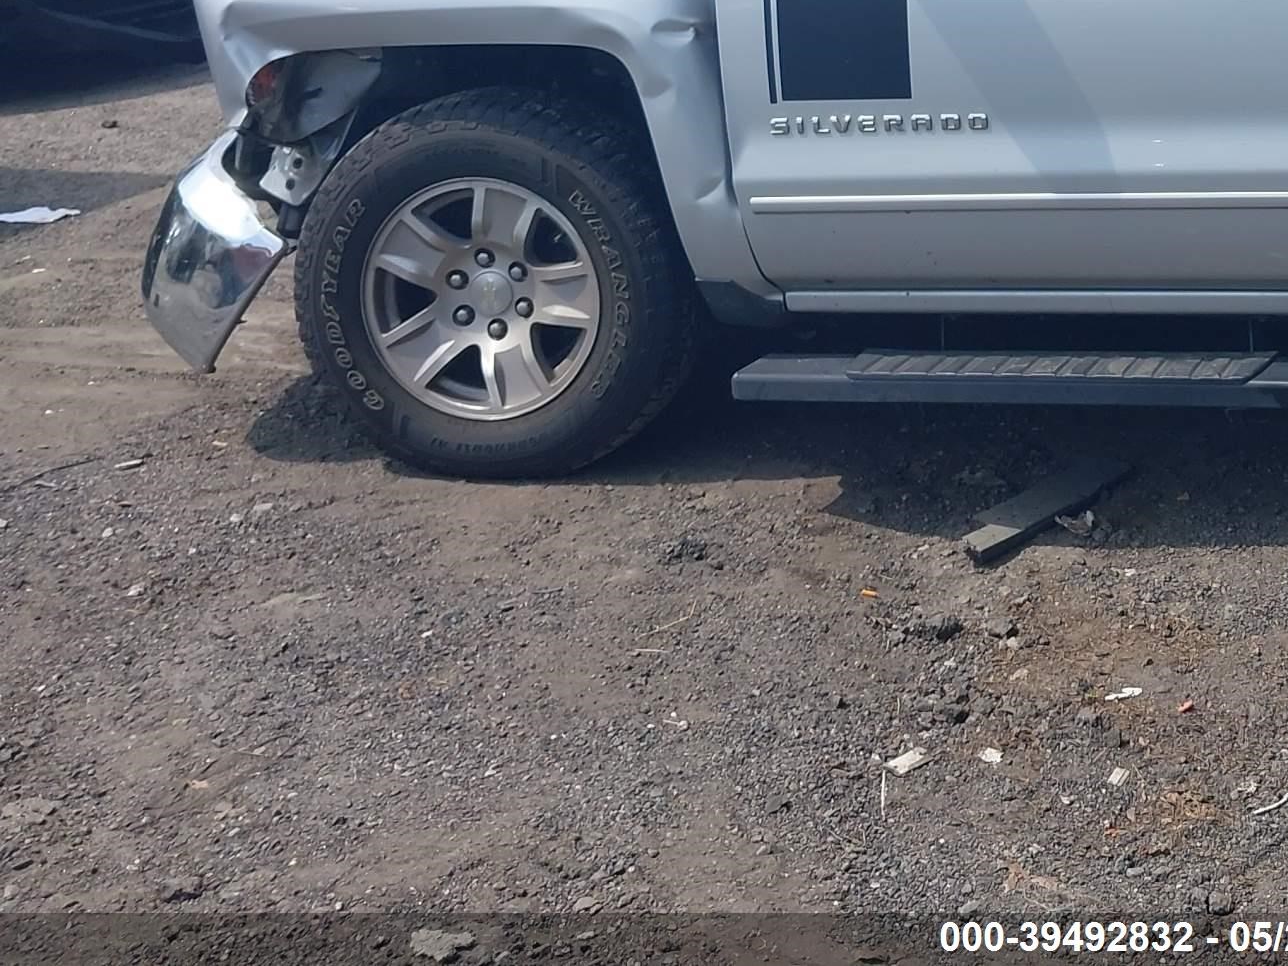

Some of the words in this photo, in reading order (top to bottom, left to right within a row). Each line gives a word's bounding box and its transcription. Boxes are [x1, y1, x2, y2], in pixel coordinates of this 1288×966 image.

[768, 112, 990, 136] SILVERADO
[320, 198, 385, 411] GOODYEAR
[568, 189, 632, 399] WRANGLER
